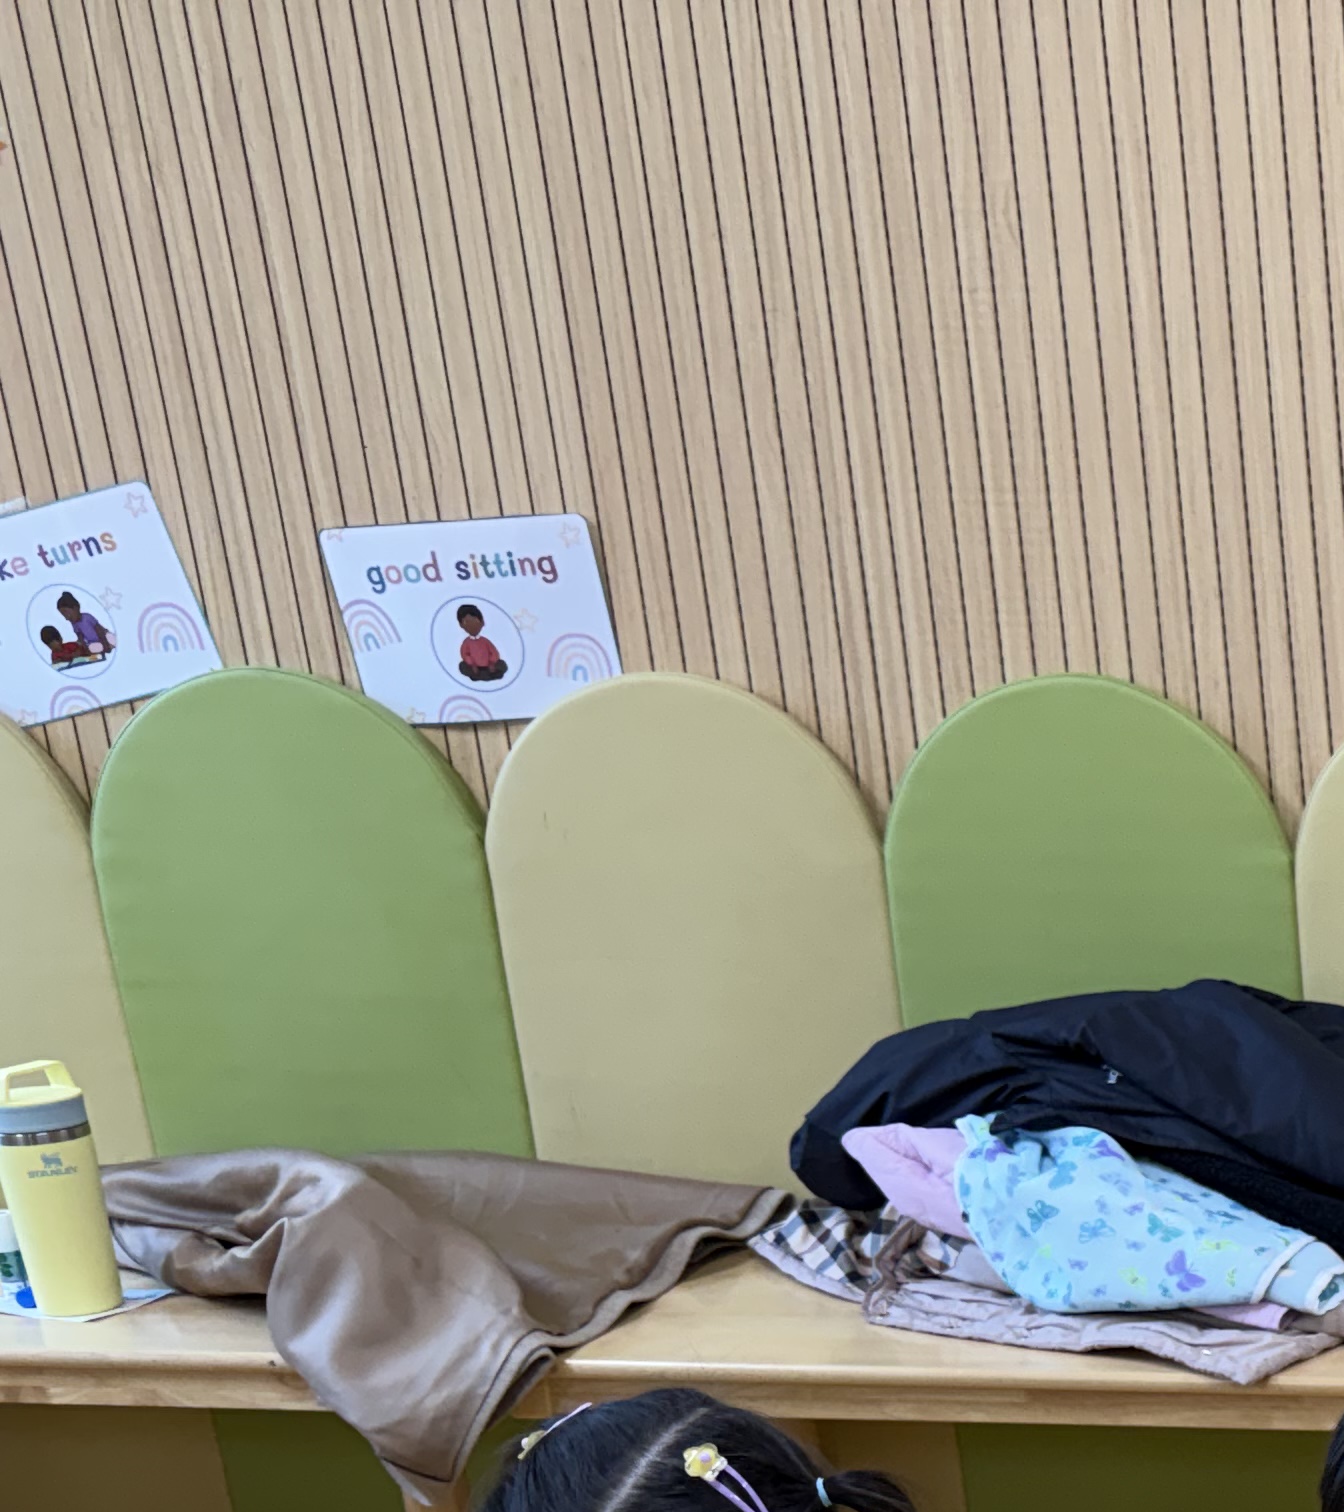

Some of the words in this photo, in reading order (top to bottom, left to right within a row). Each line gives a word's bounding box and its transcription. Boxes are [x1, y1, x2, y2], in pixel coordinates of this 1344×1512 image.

[37, 531, 118, 568] turns
[366, 550, 443, 594] good
[455, 550, 559, 584] sitting
[28, 1166, 77, 1178] STANLEY
